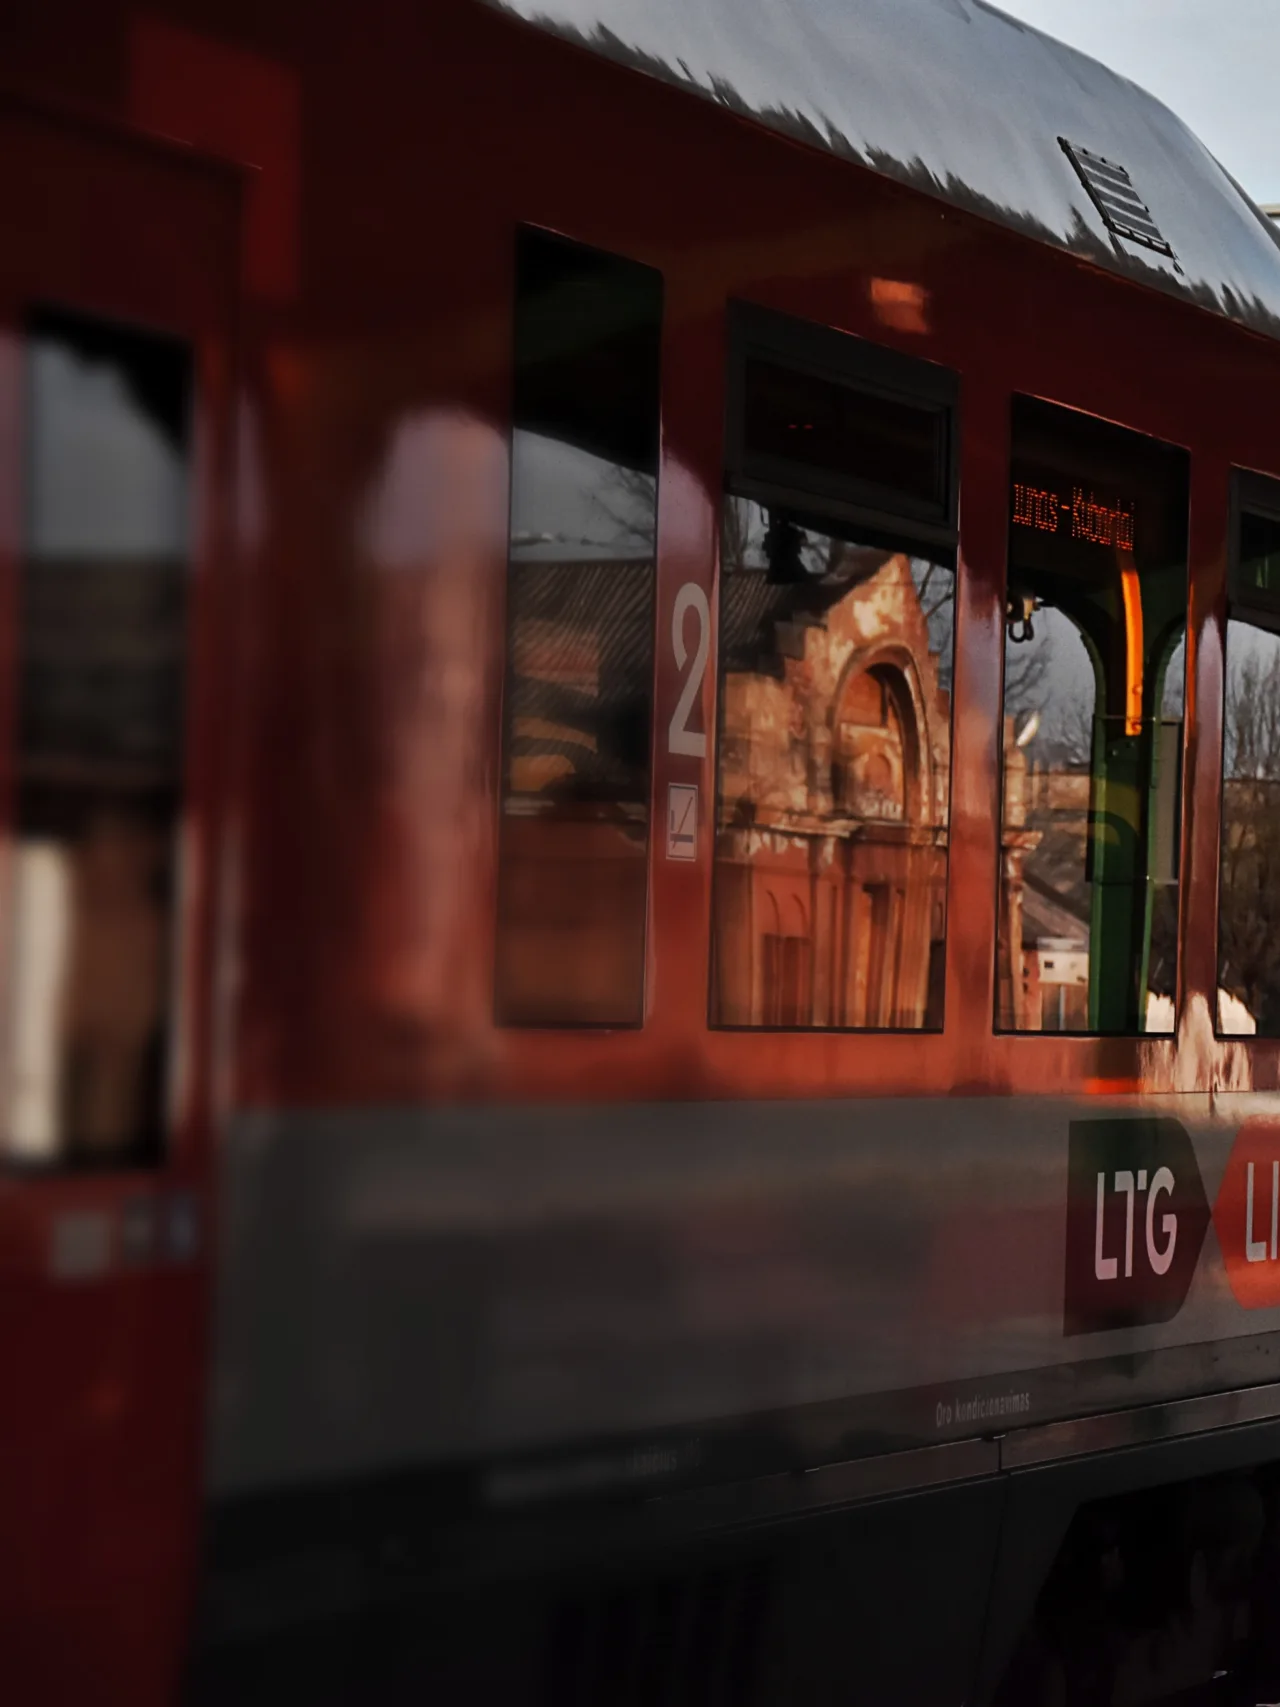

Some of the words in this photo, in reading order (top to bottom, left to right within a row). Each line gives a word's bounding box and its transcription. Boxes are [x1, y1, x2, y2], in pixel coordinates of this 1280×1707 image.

[668, 582, 711, 758] 2
[1094, 1166, 1178, 1280] LTG
[936, 1401, 952, 1428] Oro
